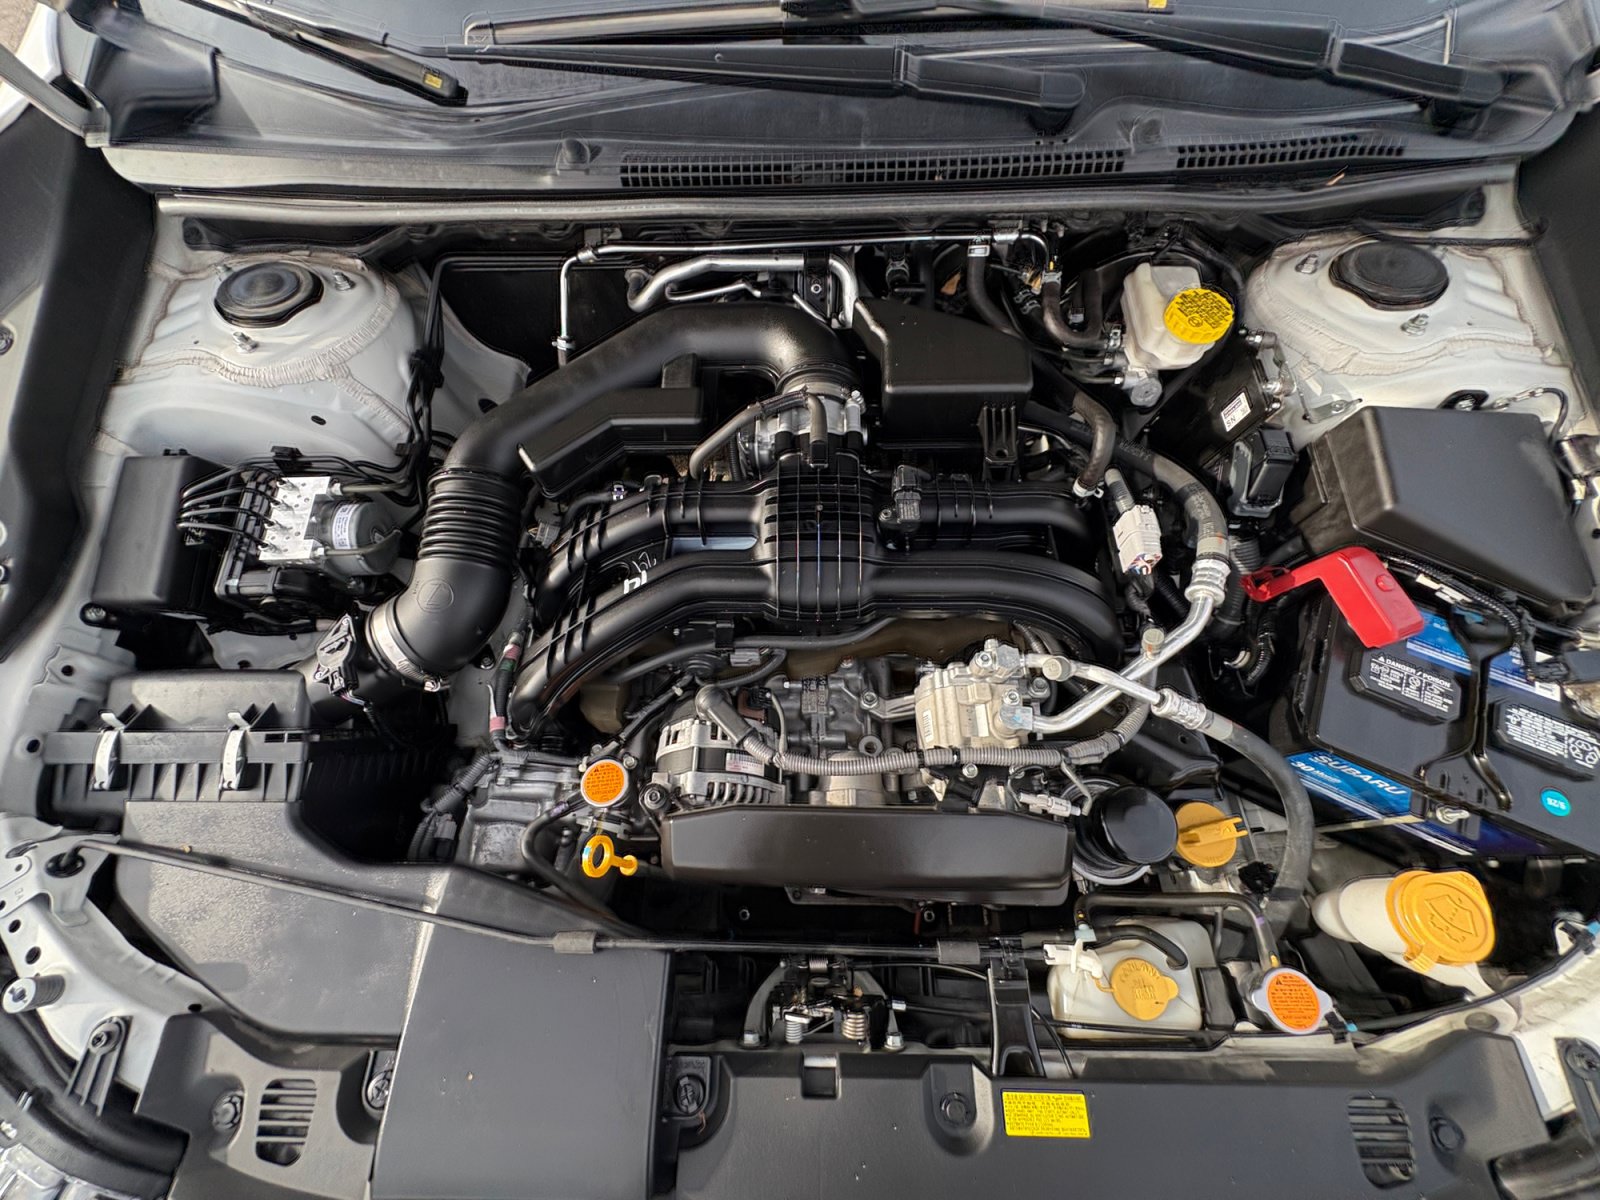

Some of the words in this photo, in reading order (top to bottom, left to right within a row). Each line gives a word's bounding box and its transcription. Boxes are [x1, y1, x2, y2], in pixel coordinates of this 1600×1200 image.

[1386, 658, 1416, 675] DANGER
[1422, 673, 1451, 689] POISON
[1291, 761, 1315, 772] 30
[1310, 755, 1407, 795] SUBARU
